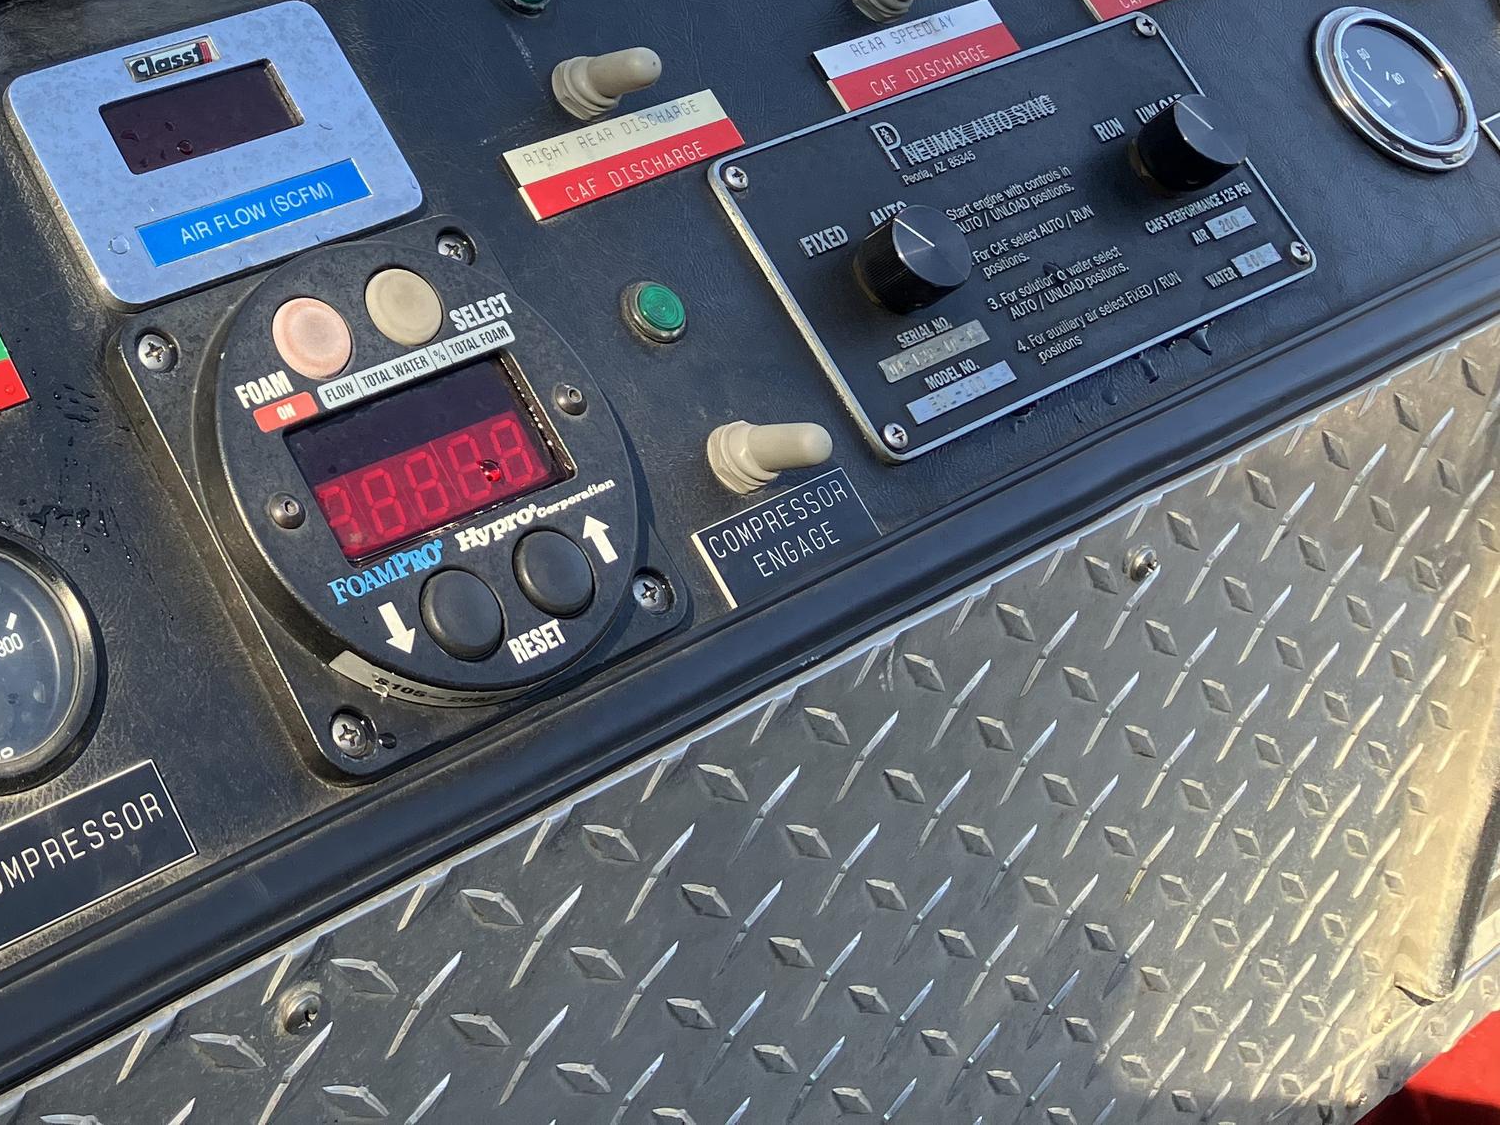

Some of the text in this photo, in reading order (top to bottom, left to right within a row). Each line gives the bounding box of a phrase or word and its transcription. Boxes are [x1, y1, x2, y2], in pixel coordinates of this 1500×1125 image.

[849, 14, 955, 58] REAR SPEEDLAY
[130, 40, 214, 77] Class1
[869, 44, 991, 96] CAF DISCHARGE
[522, 99, 700, 167] RIGHT REAR DISCHARGE
[870, 121, 973, 170] PNEUMAX
[972, 110, 1014, 141] AUTO
[1093, 117, 1126, 142] RUN
[565, 141, 707, 203] CAF DISCHARGE
[946, 164, 1071, 221] Start engine with controls in
[992, 197, 1030, 221] UNLOAD
[1030, 181, 1075, 207] positions.
[180, 182, 335, 245] AIR FLOW (SCFM)
[989, 205, 1095, 257] CAF select AUTO RUN
[1145, 194, 1224, 234] CAFS PERFORMANCE
[799, 225, 849, 257] FIXED
[1191, 229, 1211, 245] AIR
[982, 251, 1030, 279] positions.
[1000, 290, 1018, 306] For
[1066, 258, 1093, 277] water
[1092, 246, 1122, 265] select
[1205, 266, 1238, 288] WATER
[1010, 262, 1130, 320] AUTO UNLOAD positions.
[1028, 271, 1182, 348] For auxiliary select FIXED RUN
[448, 292, 514, 332] SELECT
[432, 348, 447, 362] %
[448, 325, 510, 356] TOTAL FOAM
[896, 323, 936, 349] SERIAL
[1038, 334, 1083, 365] positions
[234, 370, 294, 409] FOAM
[360, 355, 430, 389] TOTAL WATER
[924, 365, 962, 390] MODEL
[276, 403, 297, 420] ON
[324, 382, 356, 403] FLOW
[708, 479, 848, 559] COMPRESSOR
[753, 521, 840, 577] ENGAGE
[507, 619, 567, 664] RESET
